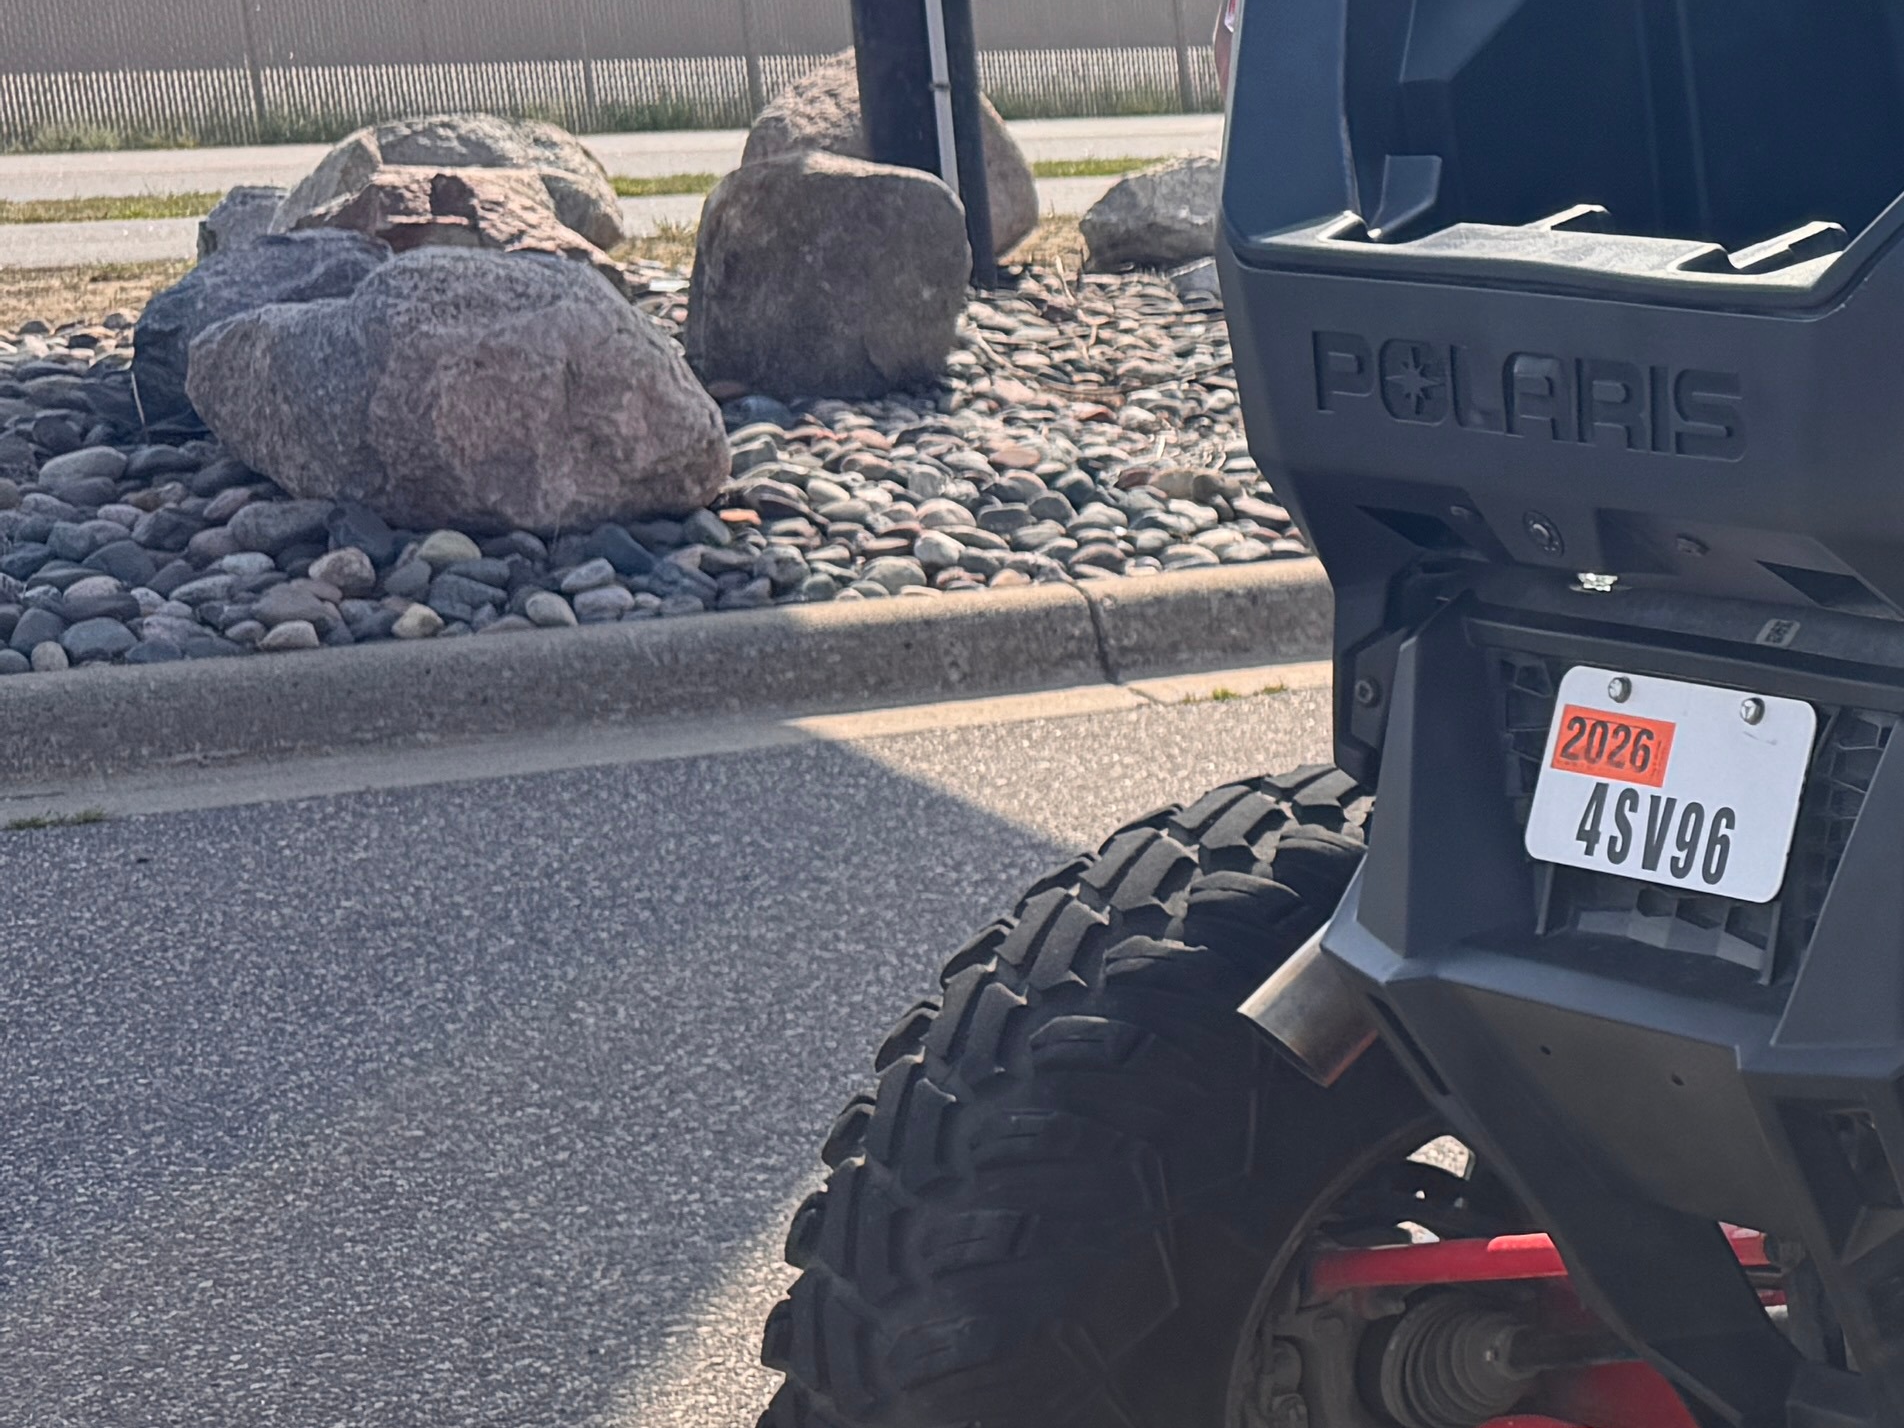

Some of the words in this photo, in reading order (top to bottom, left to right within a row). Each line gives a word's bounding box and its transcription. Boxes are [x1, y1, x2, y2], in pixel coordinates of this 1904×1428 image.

[1312, 330, 1747, 462] POLARIS
[1560, 715, 1655, 774] 2026
[1575, 781, 1736, 886] 4SV96
